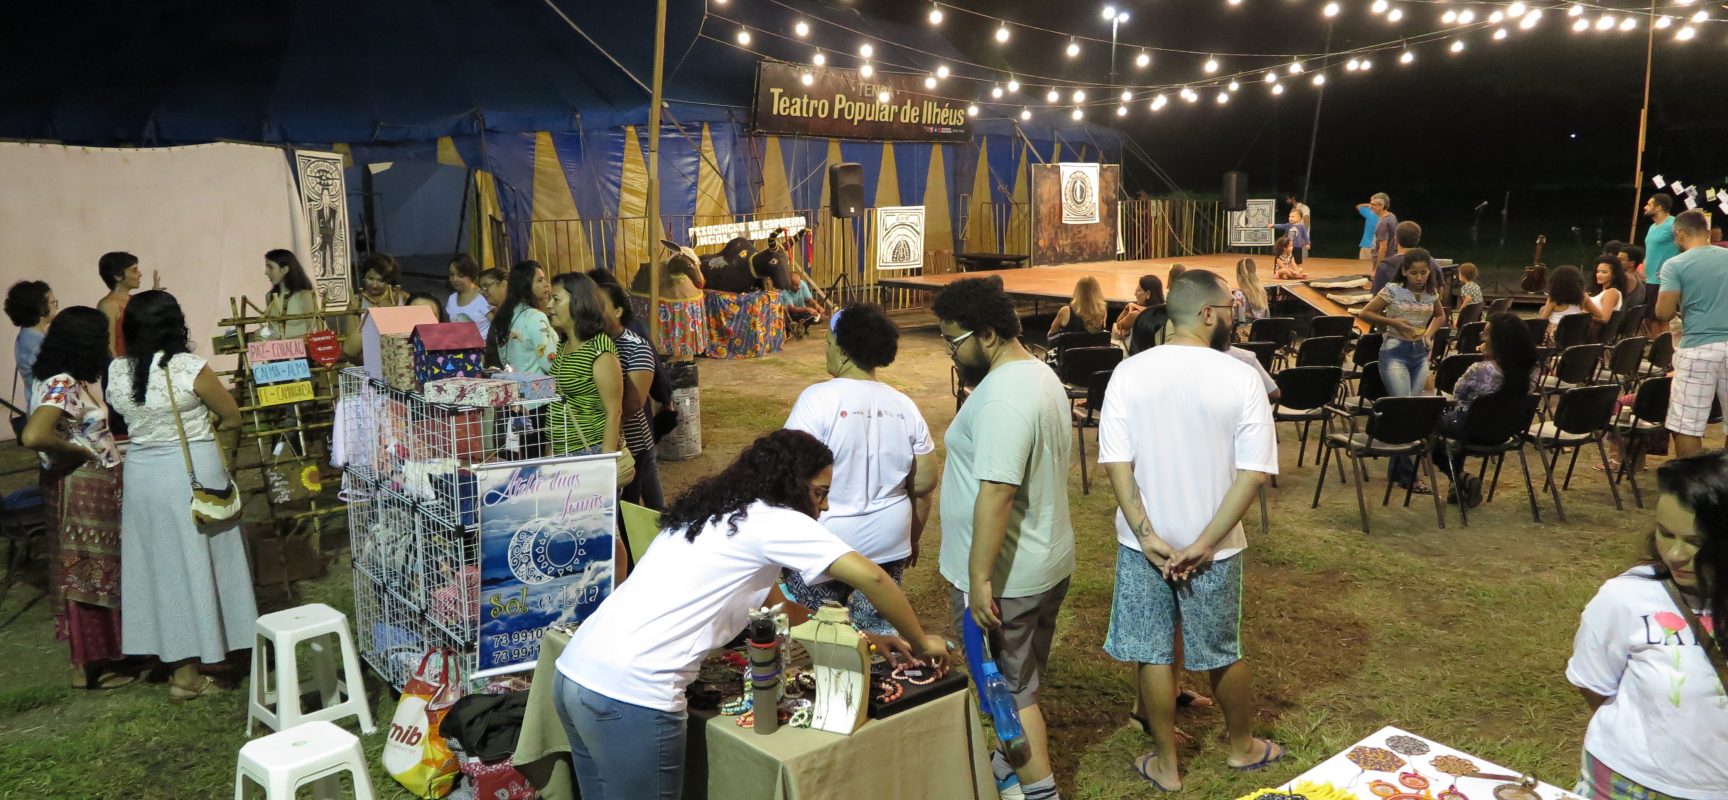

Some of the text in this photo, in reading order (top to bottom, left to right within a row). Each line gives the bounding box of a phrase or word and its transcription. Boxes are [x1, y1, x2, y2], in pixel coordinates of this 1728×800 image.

[770, 88, 965, 126] Teatro Popular de Ilhéus
[748, 220, 760, 231] DE
[490, 584, 599, 618] Sol e Lua
[492, 627, 549, 648] 73 9910
[492, 651, 509, 664] 73
